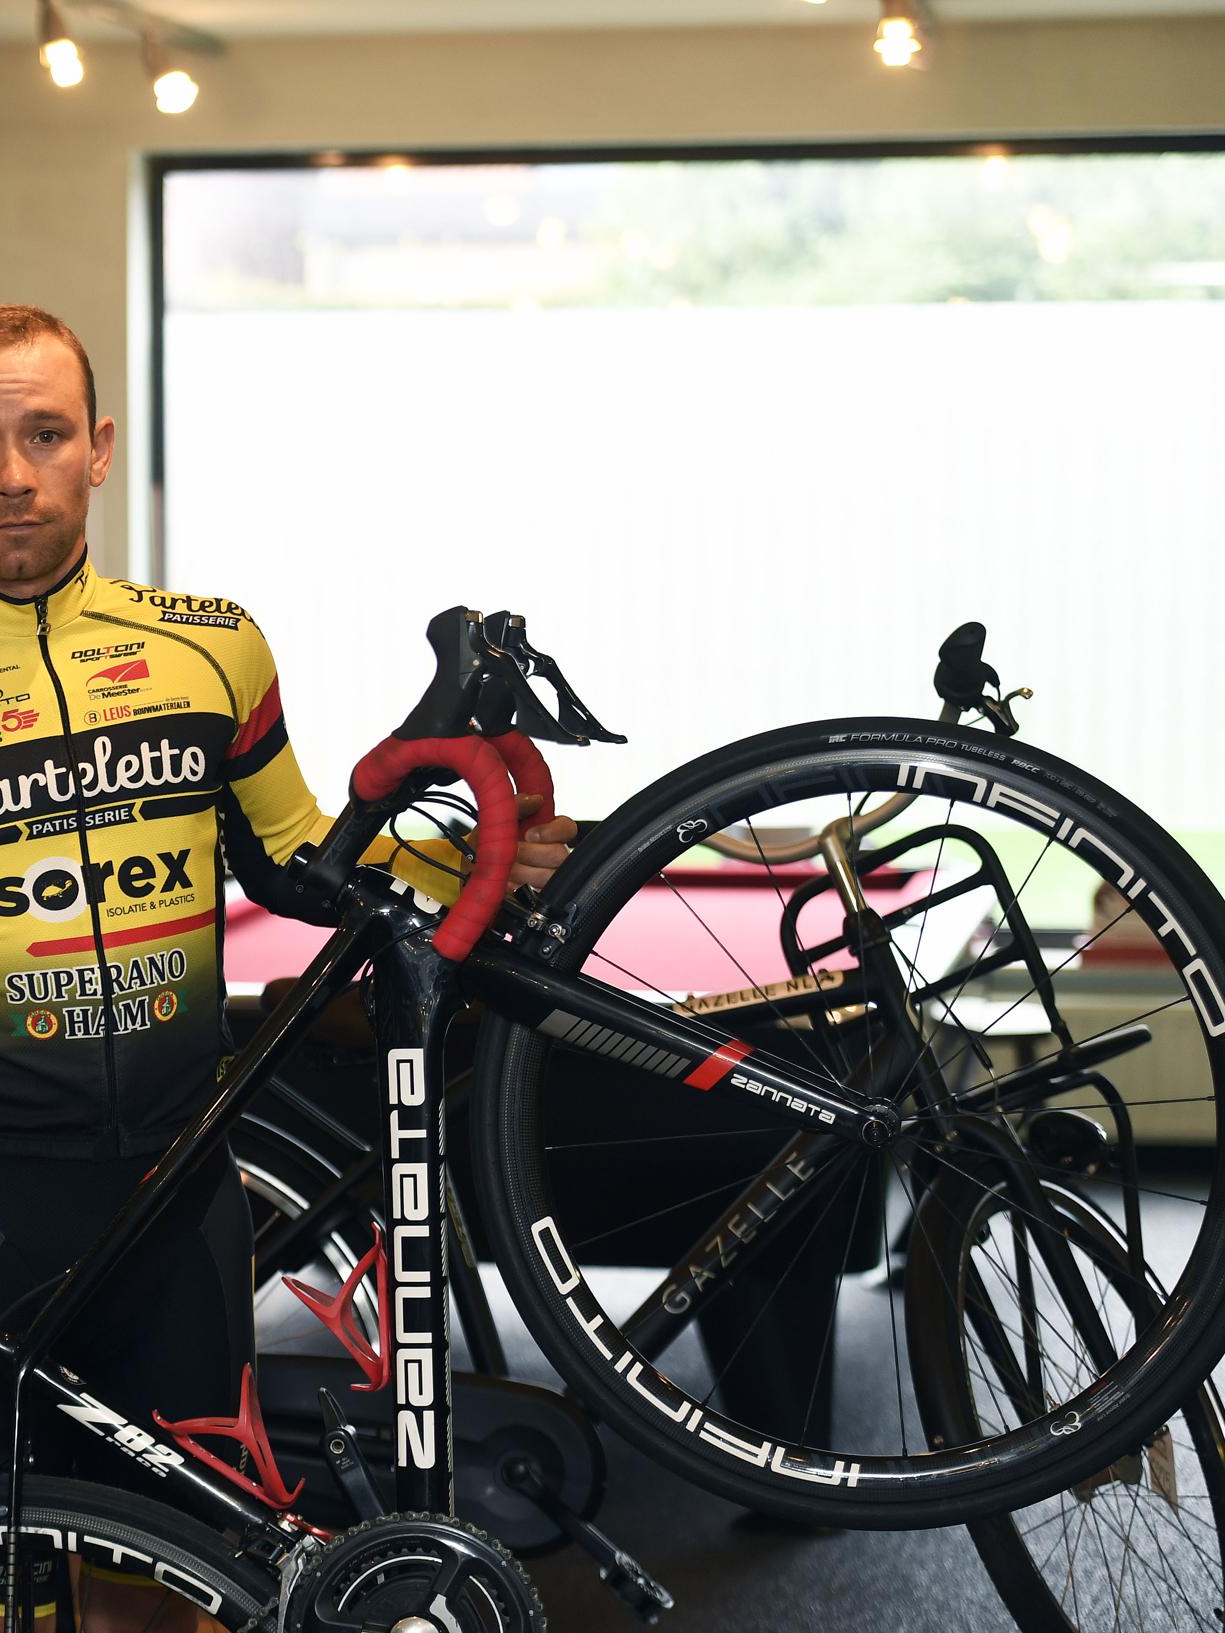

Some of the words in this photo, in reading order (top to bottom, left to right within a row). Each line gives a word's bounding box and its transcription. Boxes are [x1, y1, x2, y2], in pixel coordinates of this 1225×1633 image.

[164, 613, 237, 627] PATISSERIE
[88, 684, 128, 694] CARROSSERIE
[103, 704, 132, 722] LEUS
[132, 701, 191, 717] BOUWMATERIALEN
[850, 732, 923, 744] FORMULA
[926, 737, 958, 749] PRO
[960, 743, 1006, 761] TUBELESS
[32, 808, 130, 835] PATISSERIE
[106, 903, 148, 918] ISOLATIE
[149, 900, 157, 910] &
[158, 892, 196, 908] PLASTICS
[5, 948, 187, 1005] SUPERANO
[679, 985, 776, 1014] GAZELLE
[62, 996, 151, 1040] HAM
[662, 1152, 815, 1314] GAZELLE
[531, 1216, 860, 1488] INFINITO
[55, 1392, 186, 1473] Z82
